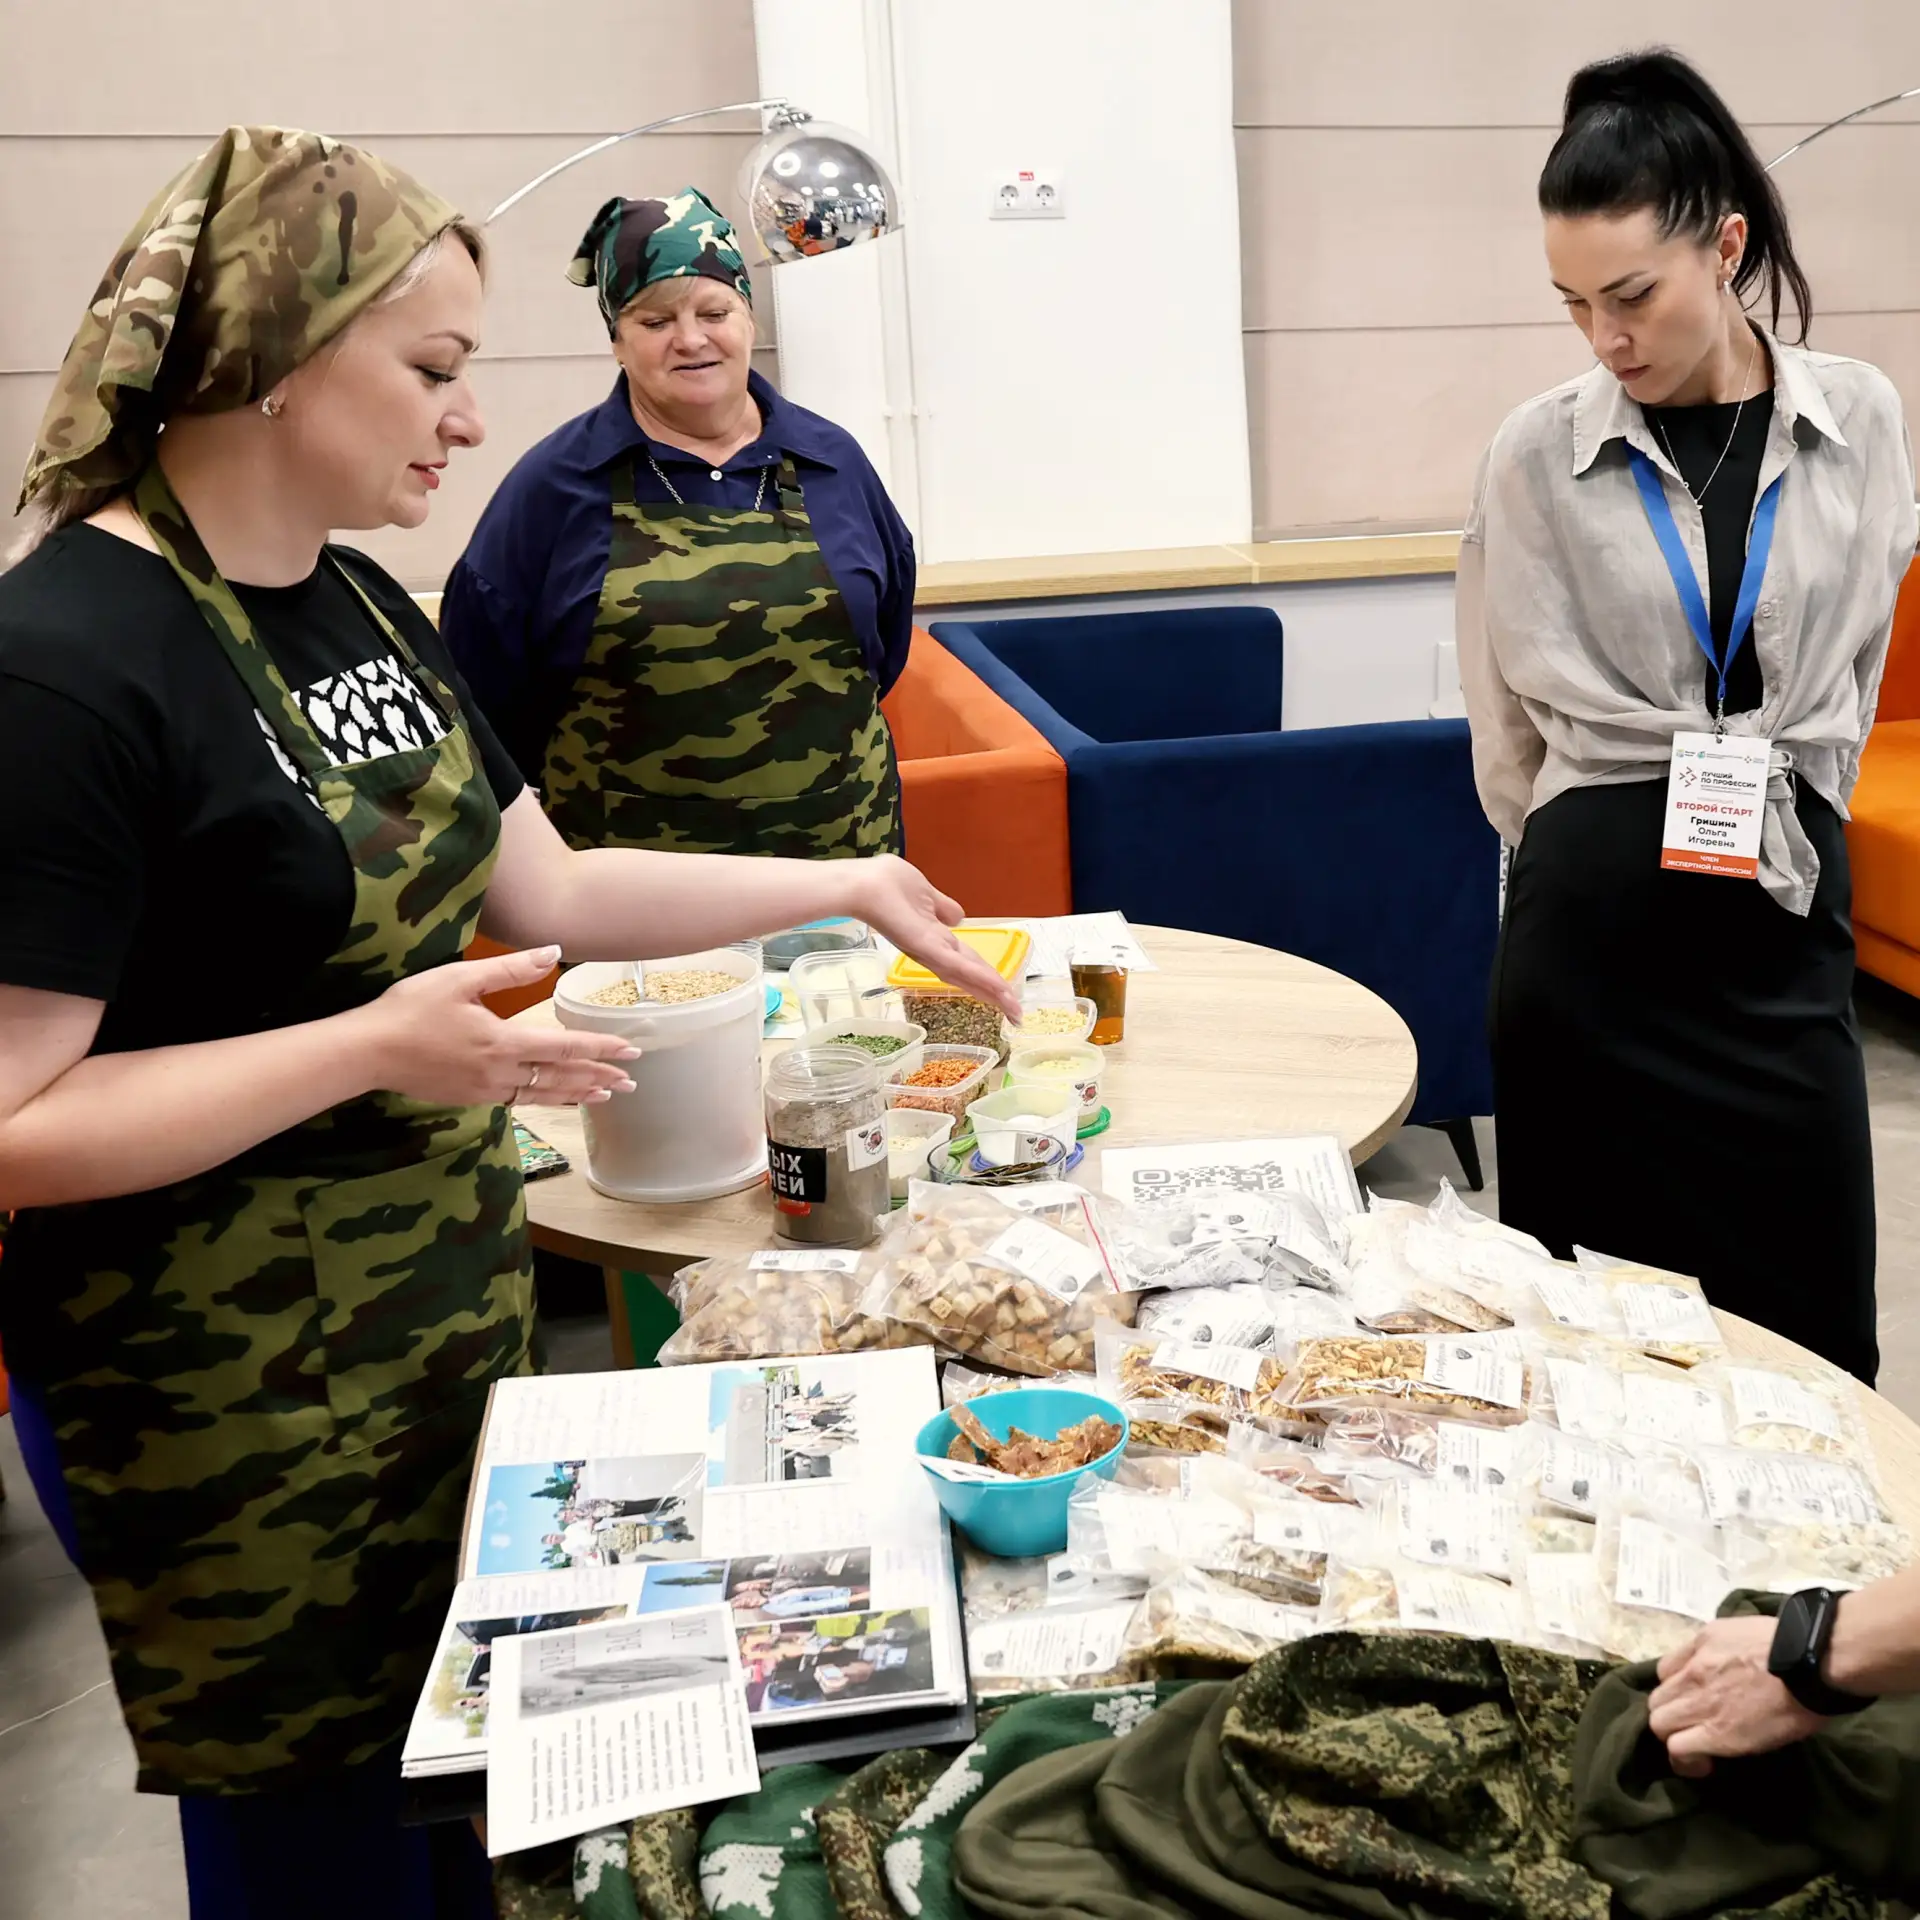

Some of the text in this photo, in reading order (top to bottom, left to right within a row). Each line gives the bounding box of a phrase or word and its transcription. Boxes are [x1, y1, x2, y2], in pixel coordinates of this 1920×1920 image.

[1701, 771, 1733, 780] ЛУЧШИЙ
[1712, 778, 1757, 788] ПРОФЕССИИ
[1676, 801, 1753, 817] ВТОРОЙ СТАРТ
[1690, 816, 1737, 829] Гришина
[1697, 827, 1728, 838] Ольга
[1687, 836, 1735, 849] Игоревна
[1700, 855, 1720, 863] ЧЛЕН
[1666, 859, 1752, 876] ЭКСПЕРТНОЙ КОМИССИИ
[769, 1145, 803, 1175] ЫХ
